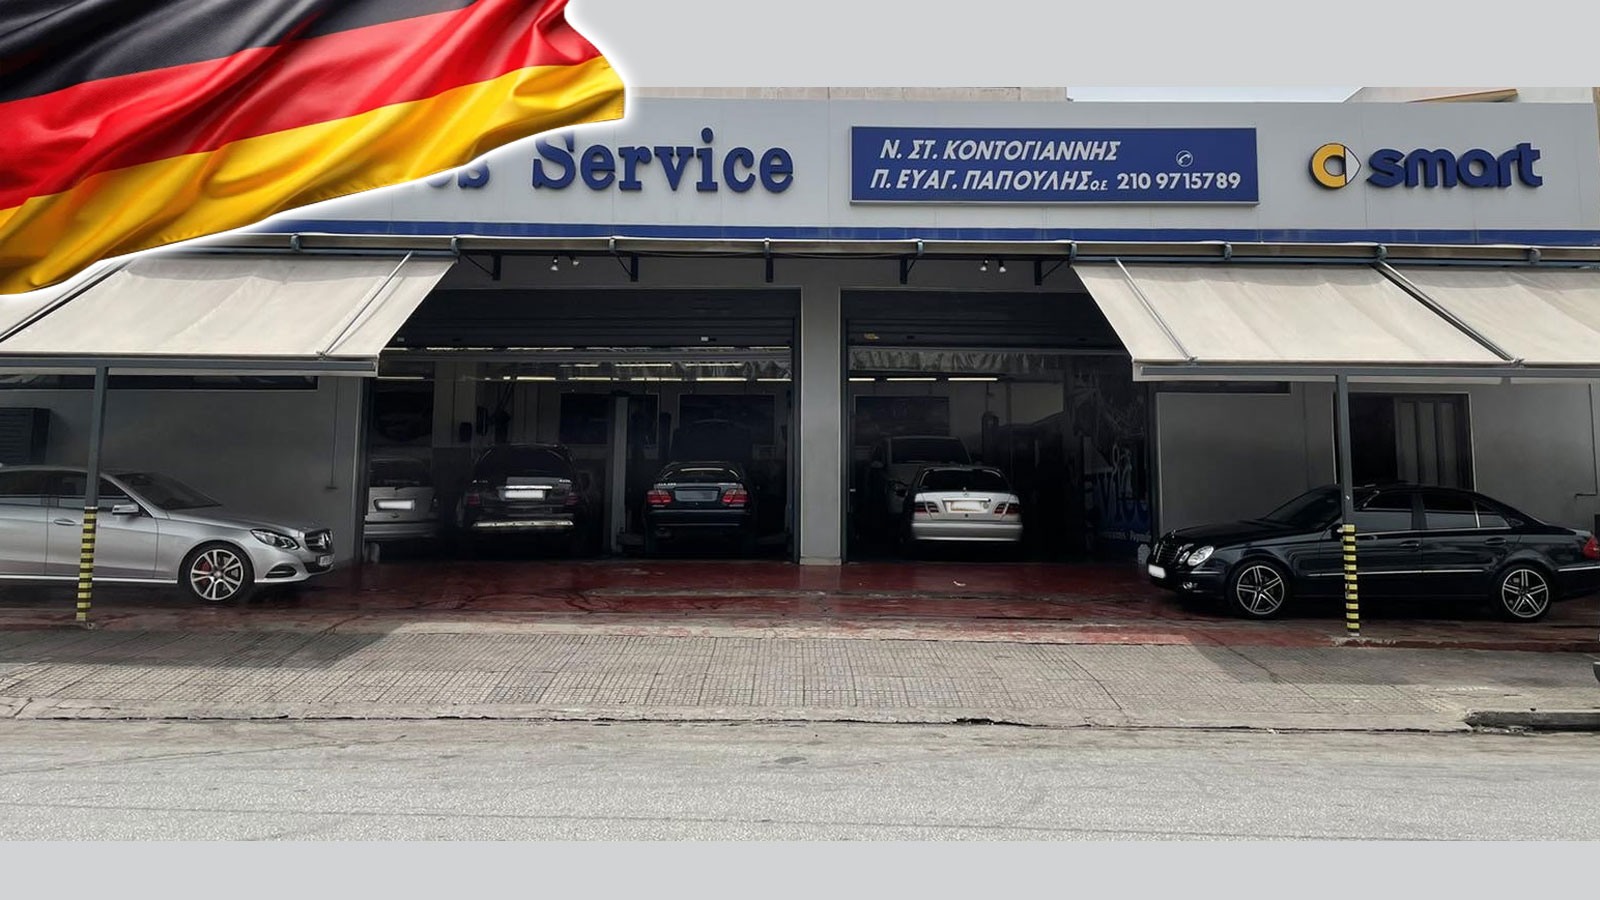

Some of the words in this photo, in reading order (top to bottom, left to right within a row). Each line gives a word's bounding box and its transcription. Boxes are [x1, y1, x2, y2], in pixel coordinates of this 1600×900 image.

[531, 127, 793, 192] Service
[879, 139, 903, 160] Ν.
[907, 140, 938, 160] ΣΤ.
[942, 140, 1121, 161] ΚΟΝΤΟΓΙΑΝΝΗΣ
[1367, 143, 1543, 188] smart
[870, 169, 892, 189] Π.
[896, 169, 958, 190] ΕΥΑΓ.
[1116, 172, 1150, 190] 210
[1155, 172, 1241, 190] 9715789
